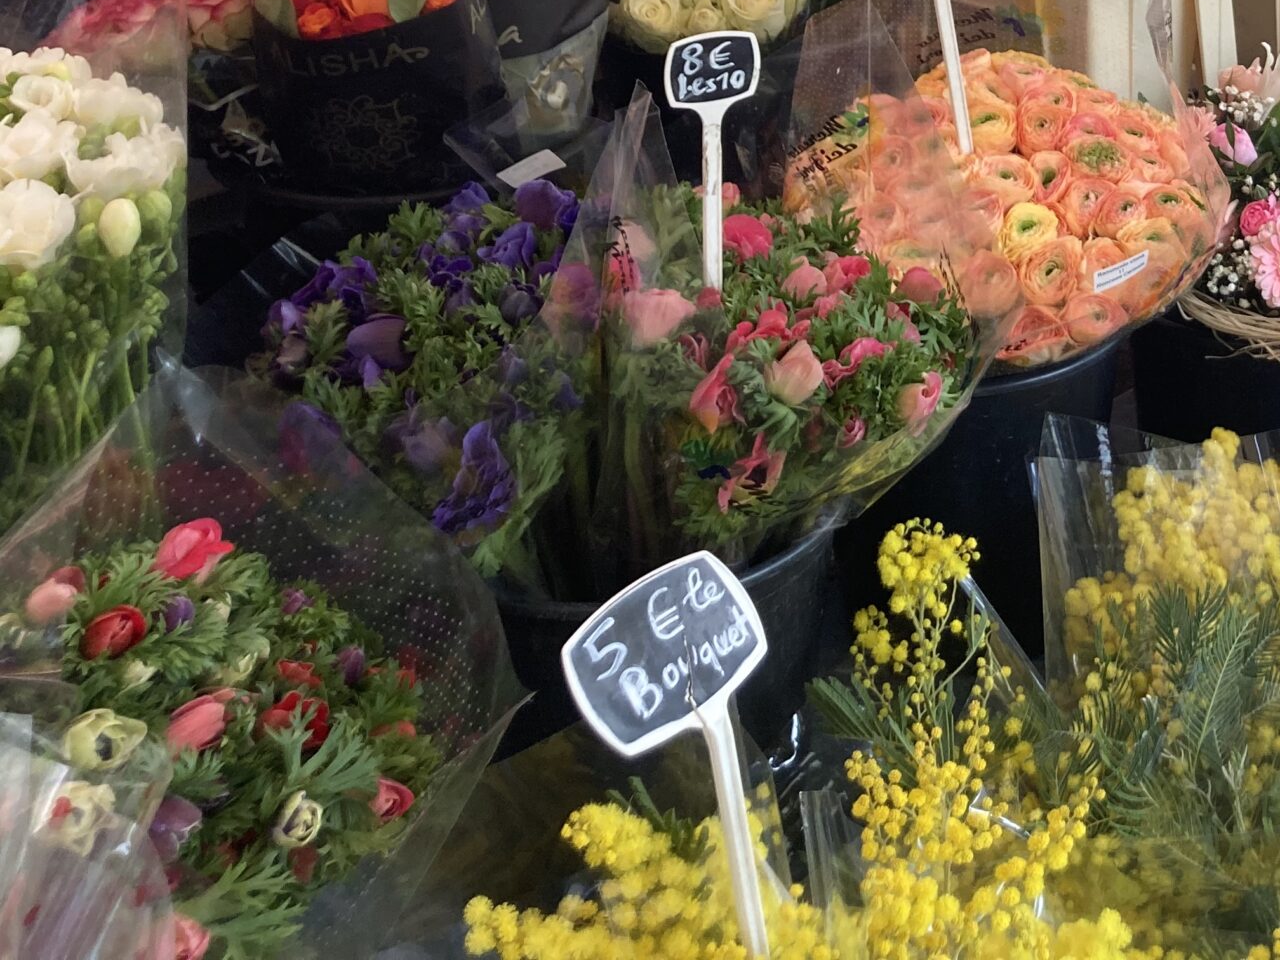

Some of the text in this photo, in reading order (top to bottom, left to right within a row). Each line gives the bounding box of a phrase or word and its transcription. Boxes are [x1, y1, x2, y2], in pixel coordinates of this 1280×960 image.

[716, 69, 746, 91] 10
[682, 567, 725, 612] le
[618, 605, 750, 720] Bouquet
